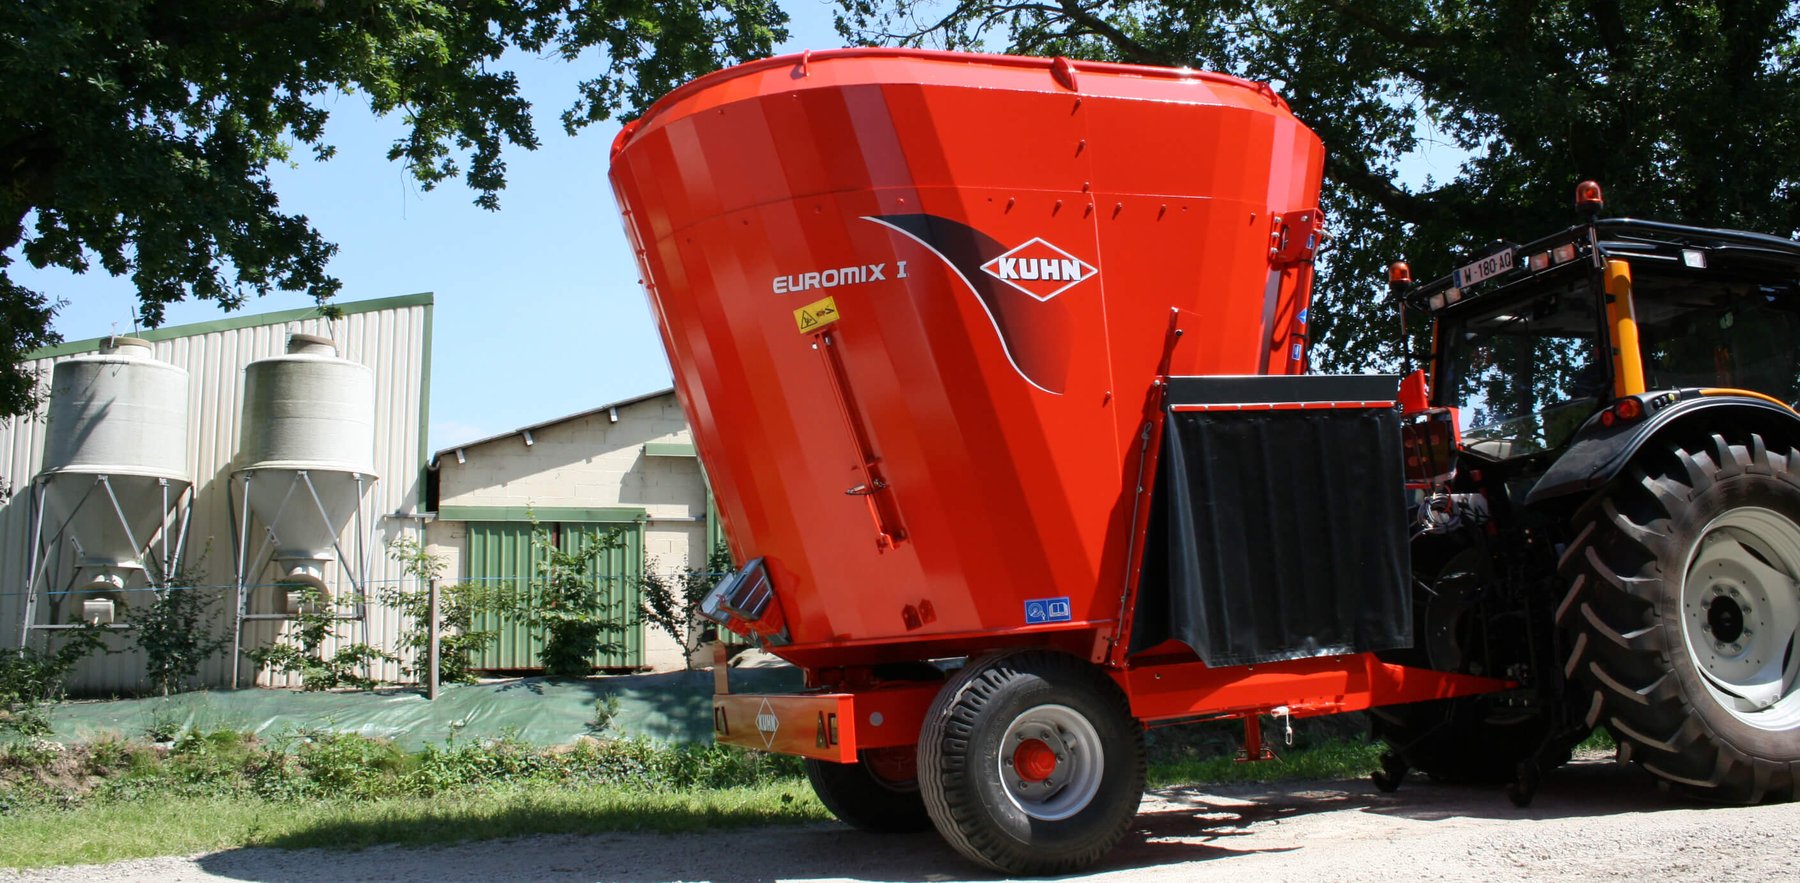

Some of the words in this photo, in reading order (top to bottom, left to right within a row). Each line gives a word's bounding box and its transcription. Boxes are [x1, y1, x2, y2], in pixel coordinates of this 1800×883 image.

[772, 263, 886, 294] EUROMIX
[896, 260, 907, 279] I
[998, 257, 1081, 281] KUHN
